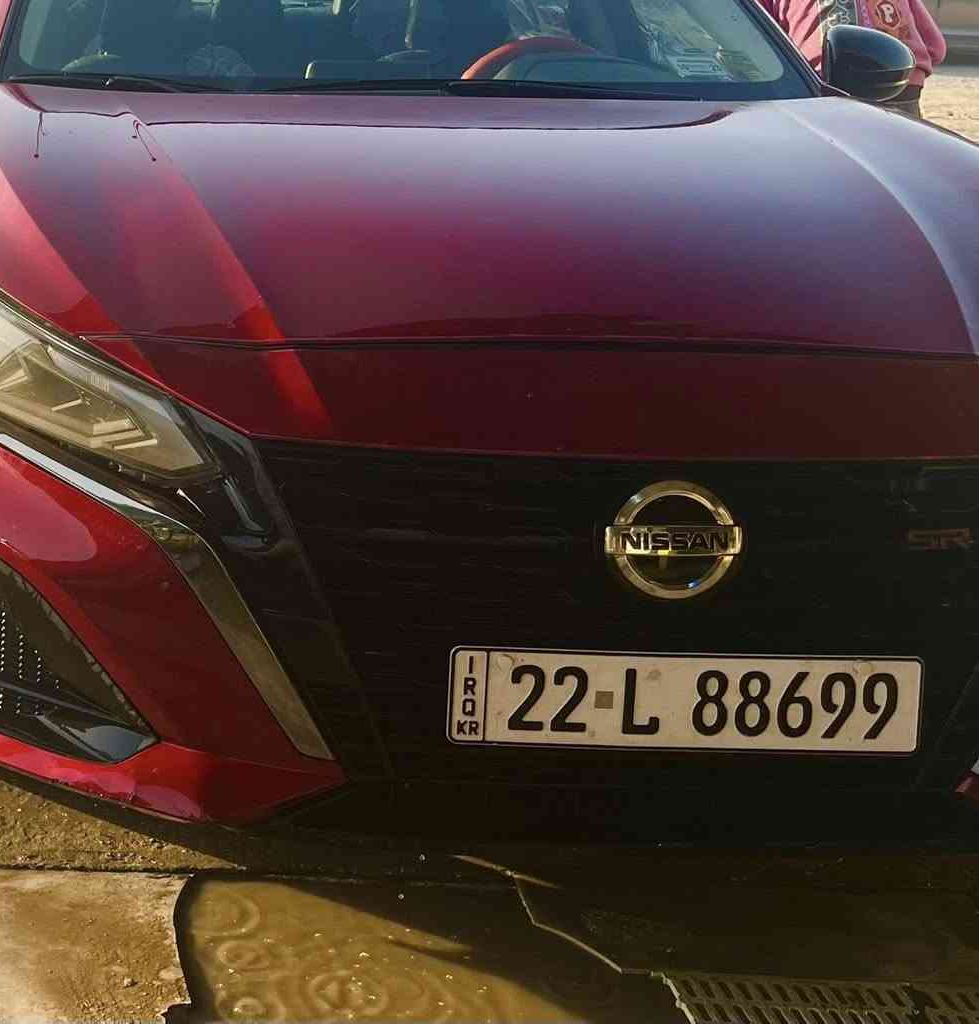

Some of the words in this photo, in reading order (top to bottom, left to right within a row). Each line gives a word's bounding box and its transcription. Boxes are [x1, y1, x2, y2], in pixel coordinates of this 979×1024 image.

[621, 530, 730, 551] NISSAN
[506, 664, 589, 733] 22
[691, 669, 899, 741] 88699
[456, 719, 479, 736] KR
